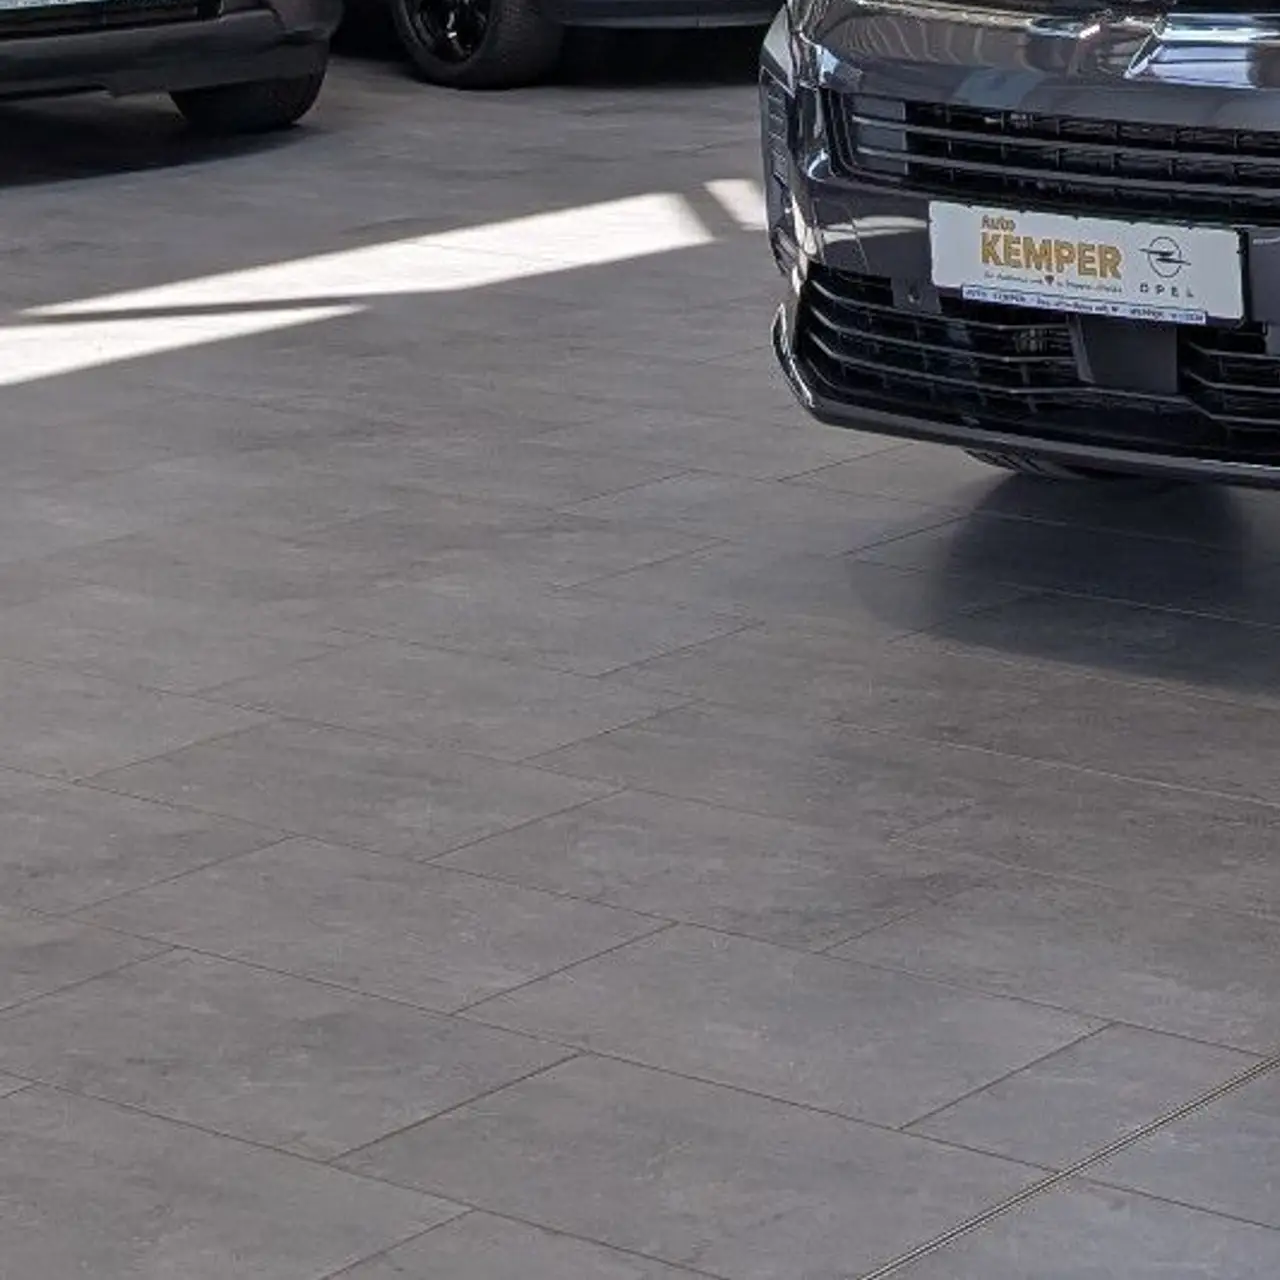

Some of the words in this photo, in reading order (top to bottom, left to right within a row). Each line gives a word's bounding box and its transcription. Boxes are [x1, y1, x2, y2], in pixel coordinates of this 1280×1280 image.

[981, 214, 1016, 231] Auto
[981, 231, 1122, 279] KEMPER
[1139, 282, 1195, 298] OPEL
